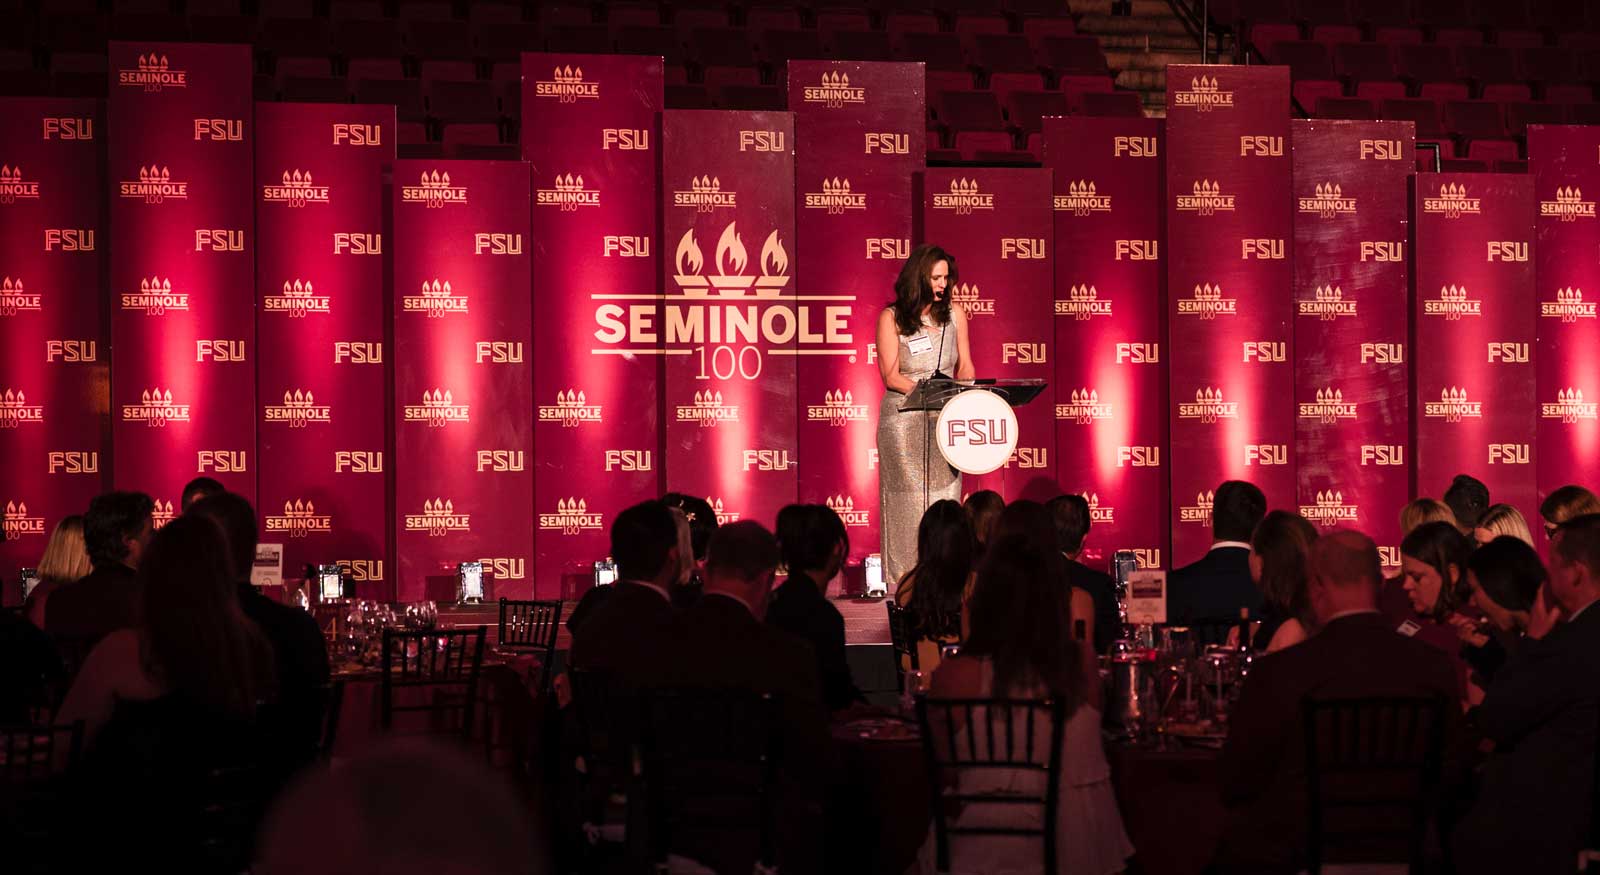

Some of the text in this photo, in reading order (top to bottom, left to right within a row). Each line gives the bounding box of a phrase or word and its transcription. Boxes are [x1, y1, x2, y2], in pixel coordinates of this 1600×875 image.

[119, 73, 185, 84] SEMINOLE
[144, 84, 161, 92] 100
[536, 84, 598, 95] SEMINOLE
[559, 94, 576, 103] 100
[804, 89, 864, 100] SEMINOLE
[1175, 94, 1233, 104] SEMINOLE
[827, 99, 843, 108] 100
[1197, 104, 1212, 112] 100
[43, 118, 93, 139] FSU
[194, 119, 243, 140] FSU
[333, 125, 380, 145] FSU
[602, 129, 648, 150] FSU
[740, 131, 784, 151] FSU
[865, 133, 909, 154] FSU
[1240, 136, 1283, 156] FSU
[1114, 137, 1157, 156] FSU
[1360, 140, 1402, 160] FSU
[121, 184, 187, 195] SEMINOLE
[264, 188, 328, 199] SEMINOLE
[403, 189, 466, 200] SEMINOLE
[145, 195, 163, 204] 100
[537, 192, 599, 203] SEMINOLE
[675, 194, 735, 204] SEMINOLE
[806, 196, 865, 206] SEMINOLE
[934, 196, 993, 206] SEMINOLE
[1054, 197, 1111, 208] SEMINOLE
[1176, 197, 1234, 208] SEMINOLE
[287, 199, 305, 208] 100
[426, 200, 443, 208] 100
[560, 202, 577, 211] 100
[697, 204, 713, 212] 100
[1299, 200, 1356, 211] SEMINOLE
[1424, 200, 1480, 211] SEMINOLE
[828, 206, 844, 214] 100
[955, 206, 972, 214] 100
[1074, 208, 1090, 216] 100
[1198, 208, 1213, 216] 100
[1541, 204, 1596, 214] SEMINOLE
[1320, 211, 1335, 219] 100
[1445, 211, 1460, 219] 100
[1561, 214, 1576, 222] 100
[45, 230, 95, 250] FSU
[195, 230, 243, 250] FSU
[334, 234, 381, 254] FSU
[475, 234, 521, 254] FSU
[604, 237, 649, 257] FSU
[866, 239, 910, 259] FSU
[1001, 239, 1045, 259] FSU
[1115, 240, 1157, 260] FSU
[1242, 240, 1284, 259] FSU
[1360, 242, 1402, 261] FSU
[1487, 242, 1528, 261] FSU
[122, 296, 187, 307] SEMINOLE
[265, 299, 330, 310] SEMINOLE
[404, 299, 467, 309] SEMINOLE
[1178, 301, 1236, 312] SEMINOLE
[146, 307, 164, 316] 100
[1055, 302, 1111, 312] SEMINOLE
[1299, 303, 1356, 313] SEMINOLE
[1424, 303, 1481, 313] SEMINOLE
[1541, 304, 1596, 315] SEMINOLE
[289, 309, 306, 318] 100
[427, 309, 444, 318] 100
[1075, 312, 1090, 321] 100
[1199, 312, 1215, 320] 100
[1320, 313, 1336, 321] 100
[1445, 312, 1460, 321] 100
[1561, 314, 1576, 323] 100
[594, 304, 853, 344] SEMINOLE
[47, 341, 96, 361] FSU
[196, 341, 245, 361] FSU
[335, 343, 382, 363] FSU
[476, 343, 522, 363] FSU
[1002, 343, 1046, 363] FSU
[1116, 343, 1158, 363] FSU
[1243, 342, 1286, 362] FSU
[1361, 344, 1403, 363] FSU
[1488, 343, 1529, 362] FSU
[696, 346, 762, 379] 100
[0, 409, 42, 419] INOLE
[123, 408, 190, 418] SEMINOLE
[265, 409, 330, 419] SEMINOLE
[405, 409, 468, 418] SEMINOLE
[539, 409, 601, 418] SEMINOLE
[677, 408, 737, 418] SEMINOLE
[808, 407, 867, 417] SEMINOLE
[1056, 406, 1112, 416] SEMINOLE
[1179, 405, 1237, 415] SEMINOLE
[1299, 406, 1356, 415] SEMINOLE
[1425, 405, 1481, 415] SEMINOLE
[1542, 406, 1597, 415] SEMINOLE
[148, 418, 165, 427] 100
[289, 419, 307, 428] 100
[428, 418, 445, 427] 100
[562, 418, 579, 427] 100
[699, 418, 716, 427] 100
[830, 417, 846, 426] 100
[1076, 415, 1091, 424] 100
[1200, 415, 1216, 424] 100
[1321, 415, 1336, 424] 100
[1446, 415, 1461, 423] 100
[1562, 415, 1577, 424] 100
[948, 419, 1007, 446] FSU
[1117, 447, 1159, 467] FSU
[1244, 445, 1287, 465] FSU
[1361, 446, 1403, 465] FSU
[1488, 444, 1530, 464] FSU
[48, 452, 98, 473] FSU
[198, 452, 246, 472] FSU
[335, 452, 382, 472] FSU
[477, 451, 523, 471] FSU
[605, 451, 650, 471] FSU
[743, 450, 788, 471] FSU
[1300, 508, 1357, 518] SEMINOLE
[3, 520, 44, 530] INOLE
[266, 519, 330, 529] SEMINOLE
[406, 517, 469, 527] SEMINOLE
[540, 516, 601, 526] SEMINOLE
[1321, 518, 1336, 526] 100
[290, 529, 307, 538] 100
[429, 527, 446, 536] 100
[563, 526, 580, 535] 100
[1376, 546, 1402, 566] SU
